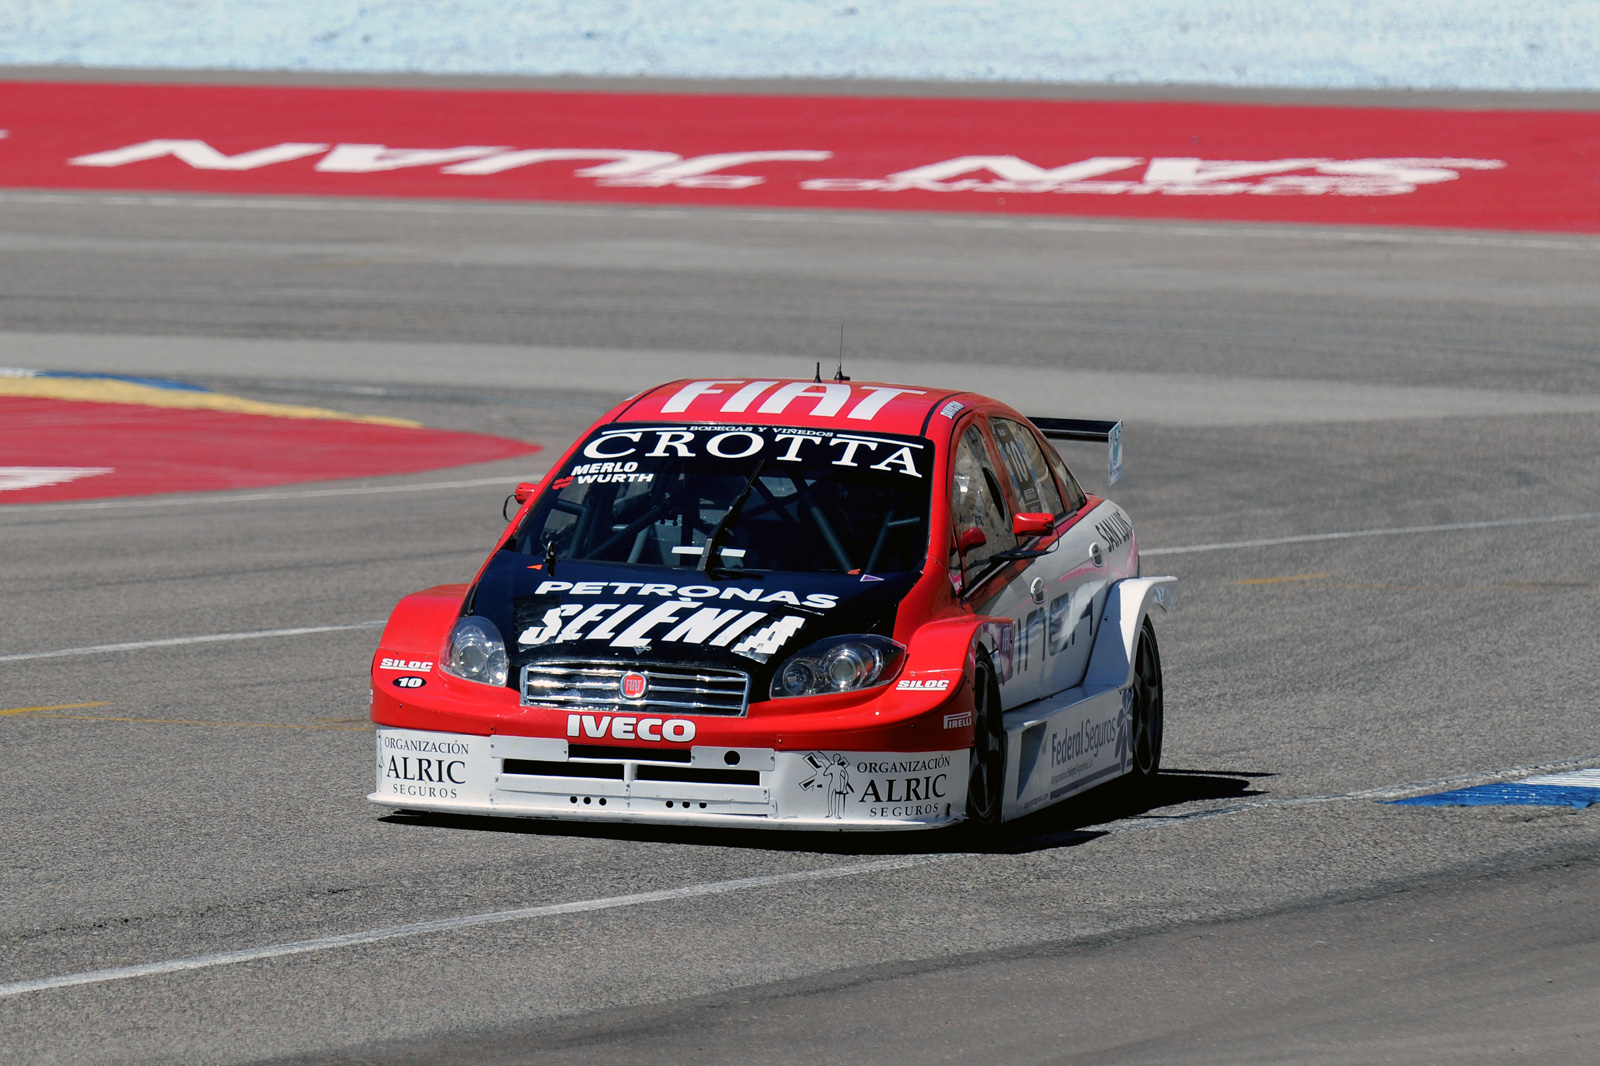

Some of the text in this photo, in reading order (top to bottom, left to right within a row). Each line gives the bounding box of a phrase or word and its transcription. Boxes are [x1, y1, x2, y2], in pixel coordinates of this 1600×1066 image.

[660, 380, 927, 421] FIAT
[583, 431, 923, 478] CROTTA
[571, 461, 639, 476] MERLO
[577, 473, 654, 484] WURTH
[534, 581, 840, 609] PETRONAS
[380, 658, 433, 671] SILOC
[397, 676, 423, 688] 10
[625, 679, 643, 692] FIAT
[896, 679, 950, 689] SILOC
[566, 713, 697, 743] IVECO
[943, 711, 972, 729] PIRELLI
[384, 736, 469, 755] ORGANIZACIÓN
[1051, 715, 1116, 768] Federal Seguros
[386, 754, 466, 785] ALRIC
[856, 754, 950, 774] ORGANIZACIÓN
[392, 783, 457, 799] SEGUROS
[858, 773, 947, 803] ALRIC
[869, 802, 939, 818] SEGUROS
